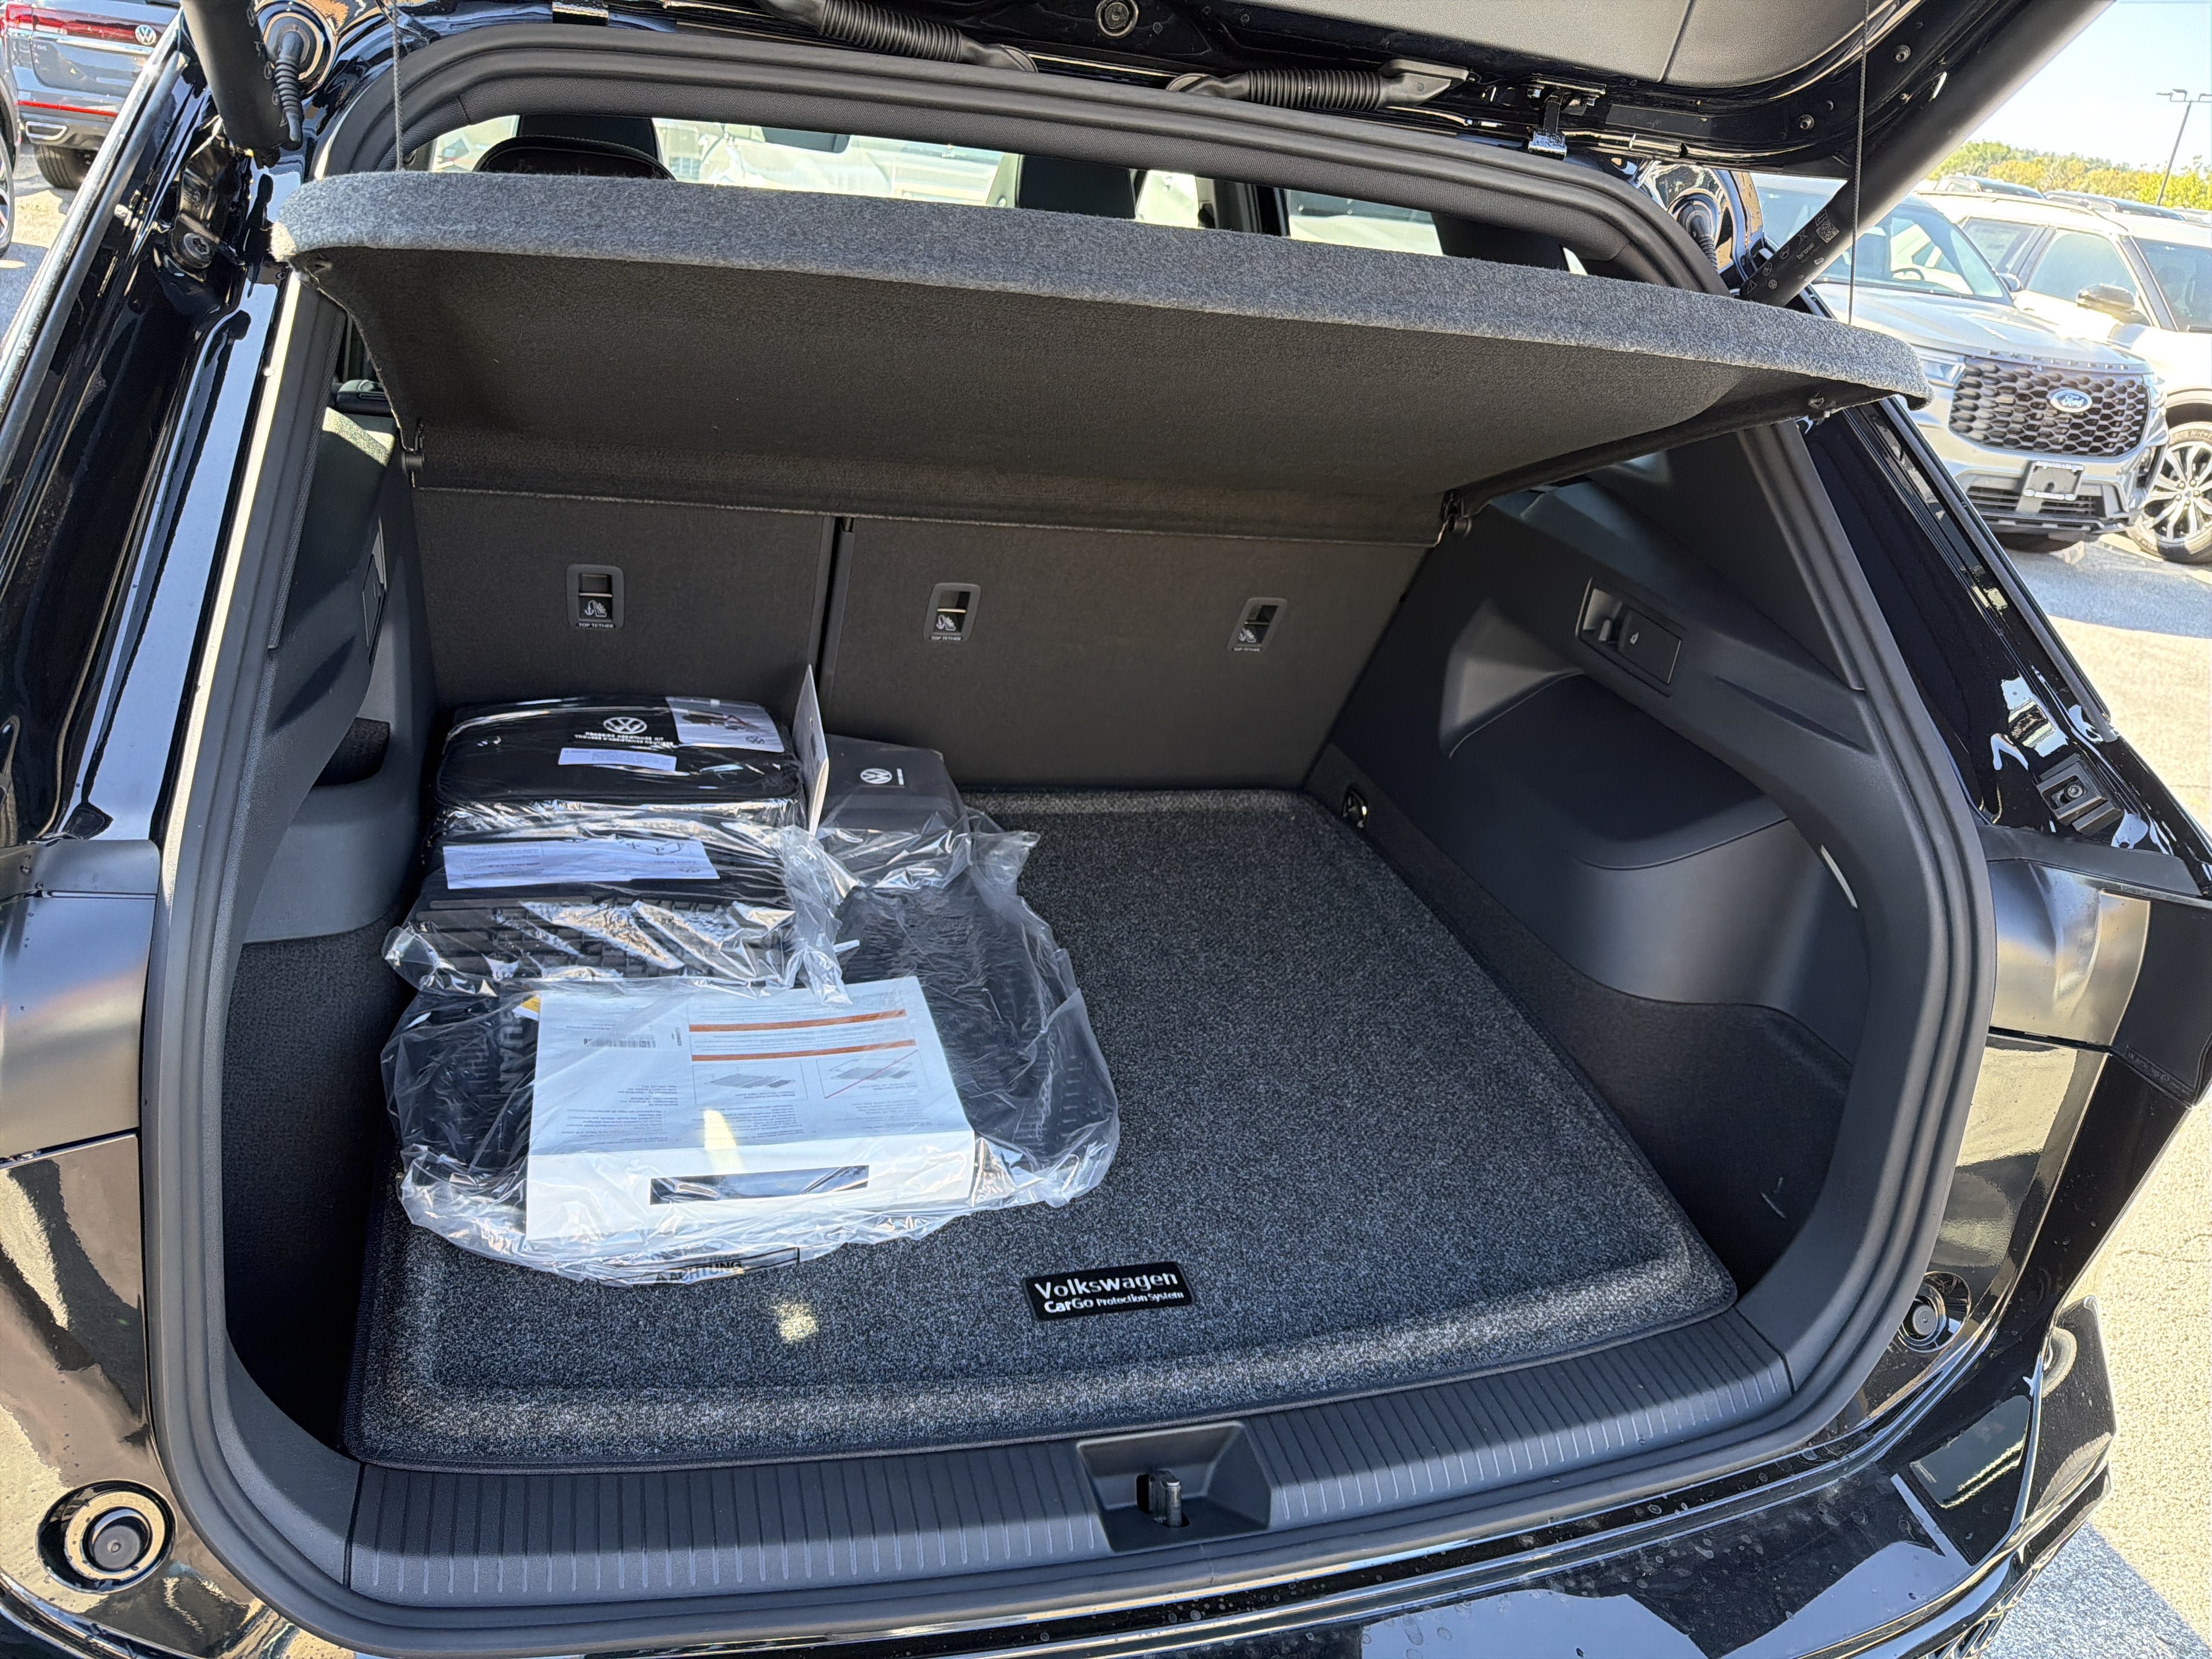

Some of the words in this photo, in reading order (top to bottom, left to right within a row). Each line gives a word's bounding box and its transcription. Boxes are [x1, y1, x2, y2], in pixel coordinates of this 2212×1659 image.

[1796, 242, 1815, 260] brose
[1034, 1272, 1178, 1300] Volkswagen
[1044, 1297, 1094, 1313] CarGo
[1096, 1293, 1148, 1307] Protection
[1147, 1291, 1184, 1303] System
